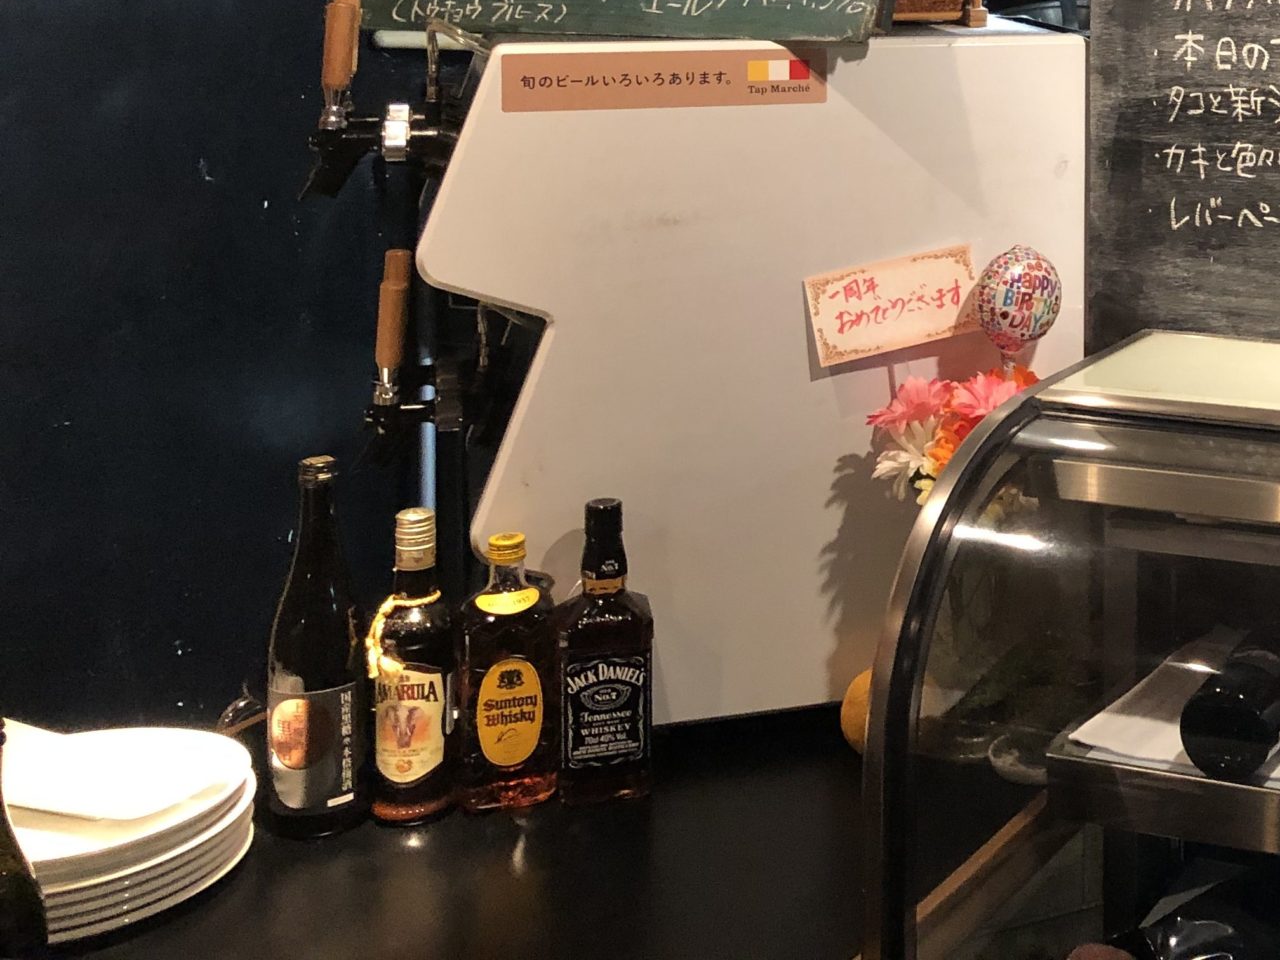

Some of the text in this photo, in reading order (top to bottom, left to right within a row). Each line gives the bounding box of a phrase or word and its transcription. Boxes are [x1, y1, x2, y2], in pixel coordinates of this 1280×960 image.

[520, 70, 732, 90] 旬のビールいろいろあります。
[747, 84, 768, 96] Tap
[566, 668, 598, 695] JACK
[376, 680, 439, 703] AMARULA
[482, 694, 538, 712] Suntory
[484, 709, 536, 727] Whisky
[580, 722, 632, 737] WHISKEY
